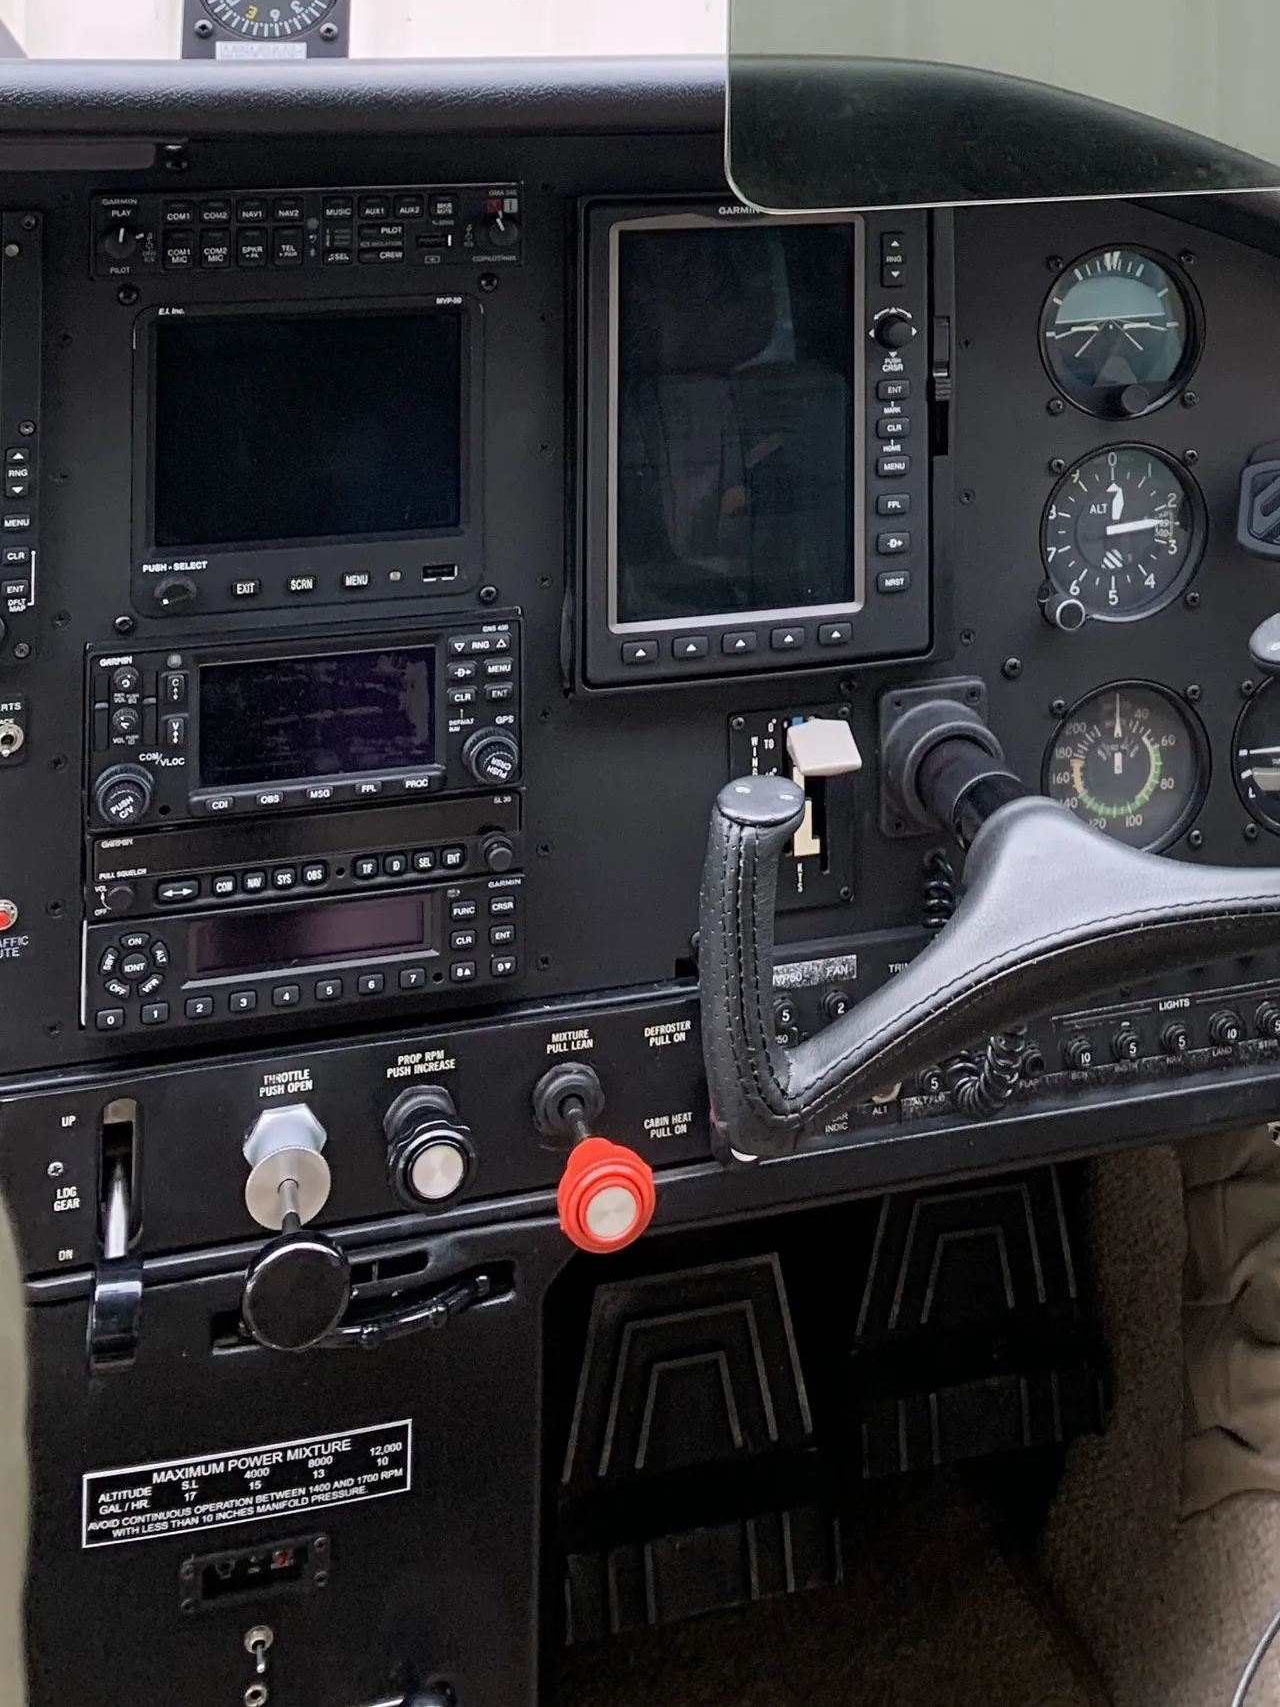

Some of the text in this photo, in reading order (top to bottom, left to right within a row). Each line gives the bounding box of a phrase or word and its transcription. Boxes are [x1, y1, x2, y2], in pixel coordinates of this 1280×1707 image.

[245, 5, 258, 20] E
[270, 9, 280, 22] 6
[111, 209, 132, 218] PLAY
[203, 211, 228, 220] COM2
[242, 210, 263, 218] NAV1
[278, 209, 300, 218] NAV2
[325, 208, 352, 216] MUSIC
[364, 207, 385, 215] AUX1
[399, 206, 420, 214] AUX2
[166, 212, 190, 221] COM1
[380, 226, 403, 235] PILOT
[167, 248, 191, 256] COM1
[203, 247, 228, 255] COM2
[379, 251, 403, 260] CREW
[171, 256, 188, 264] MIC
[887, 386, 903, 395] ENT
[886, 424, 903, 433] CLR
[1107, 451, 1117, 466] 0
[883, 462, 905, 471] MENU
[8, 469, 28, 477] RNG
[1168, 493, 1177, 507] 2
[1089, 504, 1109, 514] ALT
[4, 518, 30, 528] MENU
[7, 552, 26, 561] CLR
[142, 561, 208, 573] PUSH SELECT
[290, 579, 313, 591] SCRN
[345, 575, 368, 586] MENU
[885, 578, 905, 587] NRST
[1144, 573, 1156, 589] 4
[236, 583, 255, 594] EXIT
[1108, 590, 1118, 605] 5
[471, 640, 490, 650] RNG
[100, 656, 133, 667] GARMIN
[487, 664, 511, 674] MENU
[454, 694, 471, 702] CLR
[495, 715, 514, 724] GPS
[1161, 734, 1176, 746] 60
[1055, 746, 1072, 759] 180
[405, 778, 429, 788] PROC
[1052, 772, 1070, 784] 160
[361, 784, 377, 793] FPL
[1160, 778, 1174, 790] 80
[260, 794, 280, 804] OBS
[310, 789, 331, 798] MSG
[211, 800, 229, 810] CDI
[1125, 814, 1143, 827] 100
[488, 878, 521, 889] GARMIN
[453, 906, 475, 916] FUNC
[491, 901, 514, 911] CRSR
[456, 936, 472, 945] CLR
[495, 931, 511, 940] ENT
[127, 937, 142, 947] ON
[124, 963, 145, 973] IDNT
[1158, 998, 1190, 1011] LIGHTS
[644, 1020, 691, 1037] DEFROSTER
[551, 1029, 589, 1043] MIXTURE
[649, 1033, 686, 1047] PULL ON
[546, 1039, 594, 1054] PULL LEAN
[398, 1050, 445, 1066] PROP RPM
[387, 1059, 456, 1079] PUSH INCREASE
[263, 1069, 310, 1084] THROTTLE
[259, 1080, 313, 1097] PUSH OPEN
[61, 1115, 76, 1127] UP
[644, 1112, 693, 1130] CABIN HEAT
[650, 1124, 687, 1139] PULL ON
[56, 1186, 77, 1199] LDG
[53, 1198, 80, 1212] GEAR
[58, 1250, 73, 1261] DN
[152, 1439, 352, 1485] MAXIMUM POWER MIXTURE
[98, 1486, 152, 1504] ALTITUDE
[244, 1466, 270, 1479] 4000
[308, 1455, 333, 1468] 8000
[369, 1441, 403, 1457] 12,000
[99, 1505, 122, 1515] GAL
[183, 1491, 197, 1502] 17
[248, 1480, 262, 1491] 15
[312, 1468, 325, 1480] 13
[376, 1456, 389, 1467] 10
[87, 1468, 403, 1532] AVOID CONTINUOUS OPERATION BETWEEN 1400 AND 1700 RPM
[112, 1485, 368, 1538] WITH LESS THAN 10 INCHES MANIFOLD PRESSURE.
